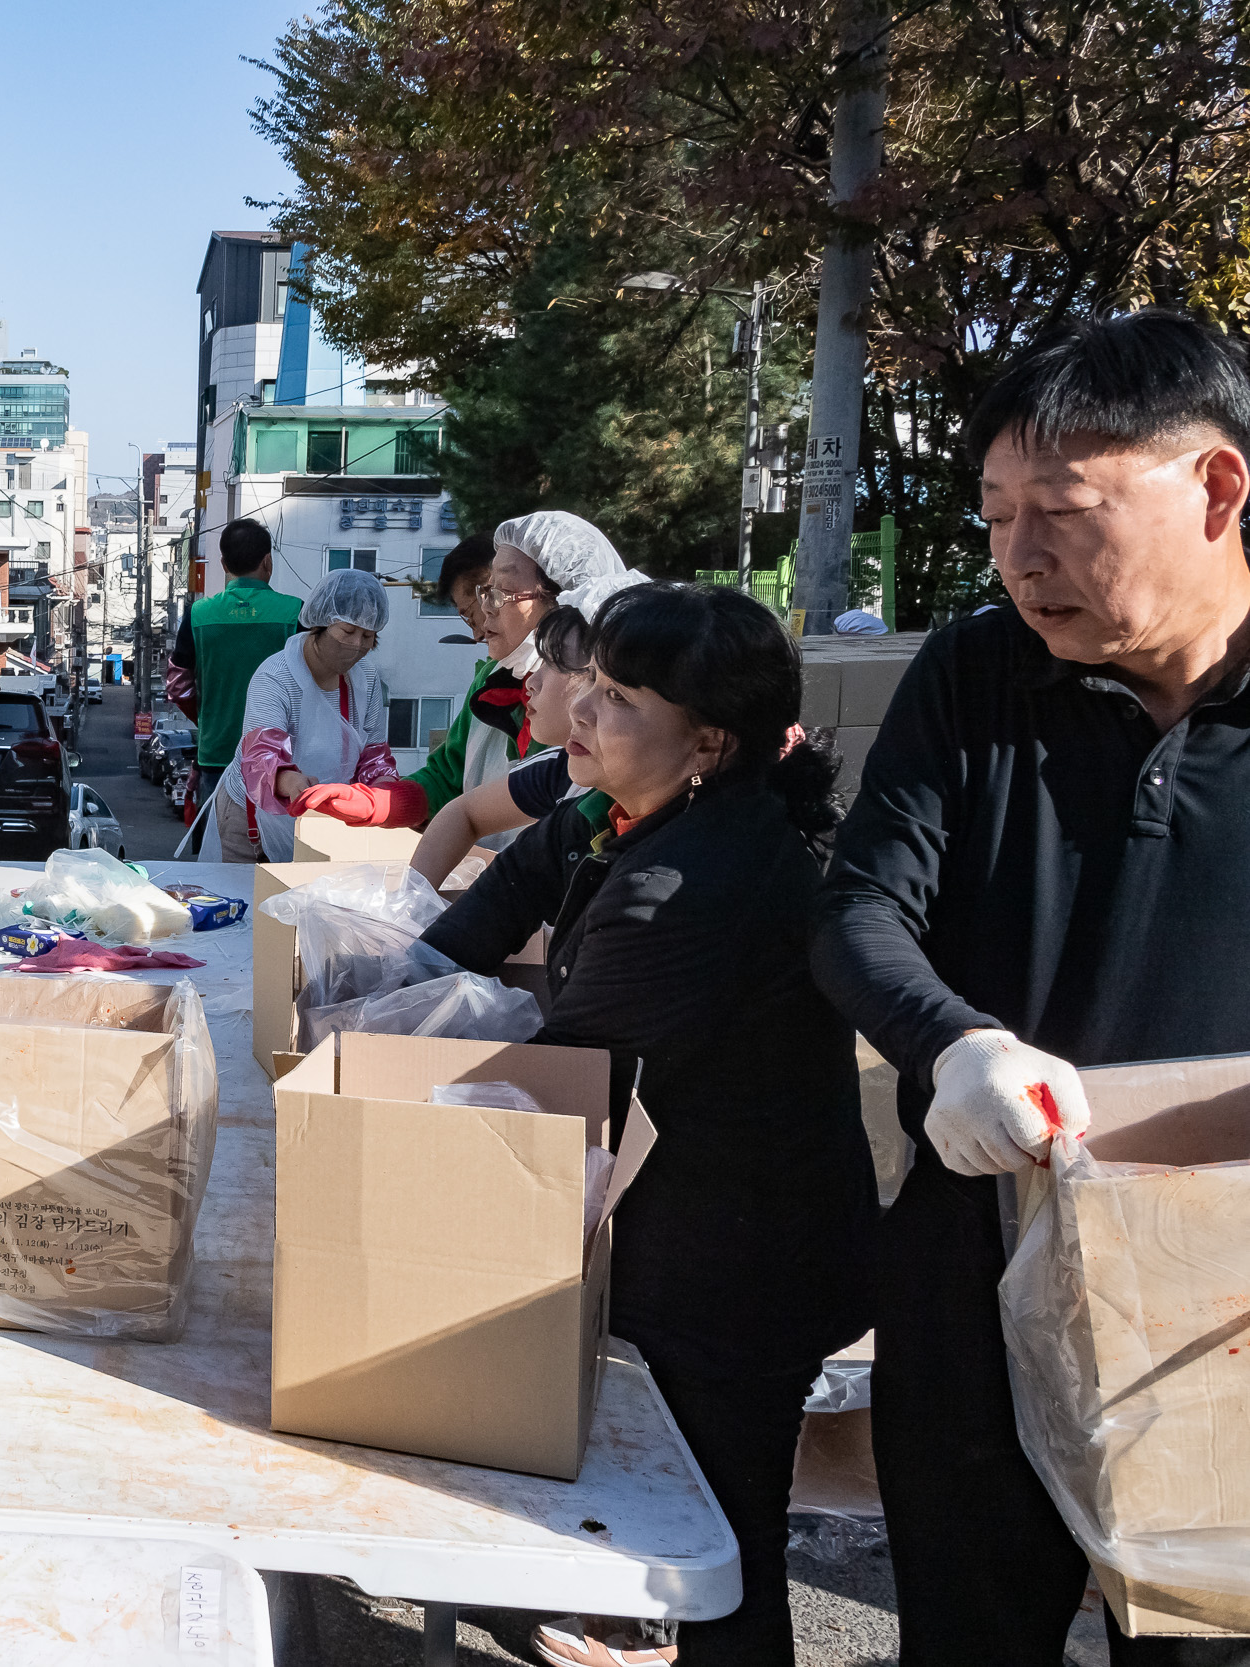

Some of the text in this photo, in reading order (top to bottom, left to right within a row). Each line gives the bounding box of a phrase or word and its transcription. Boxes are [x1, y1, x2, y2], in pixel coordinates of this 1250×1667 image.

[14, 1202, 37, 1212] 광진구
[41, 1204, 63, 1213] 따뜻한
[15, 1214, 45, 1230] 김장
[52, 1216, 128, 1237] 담가드리기
[65, 1242, 104, 1252] 11.13(수)
[10, 1283, 36, 1293] 자양점
